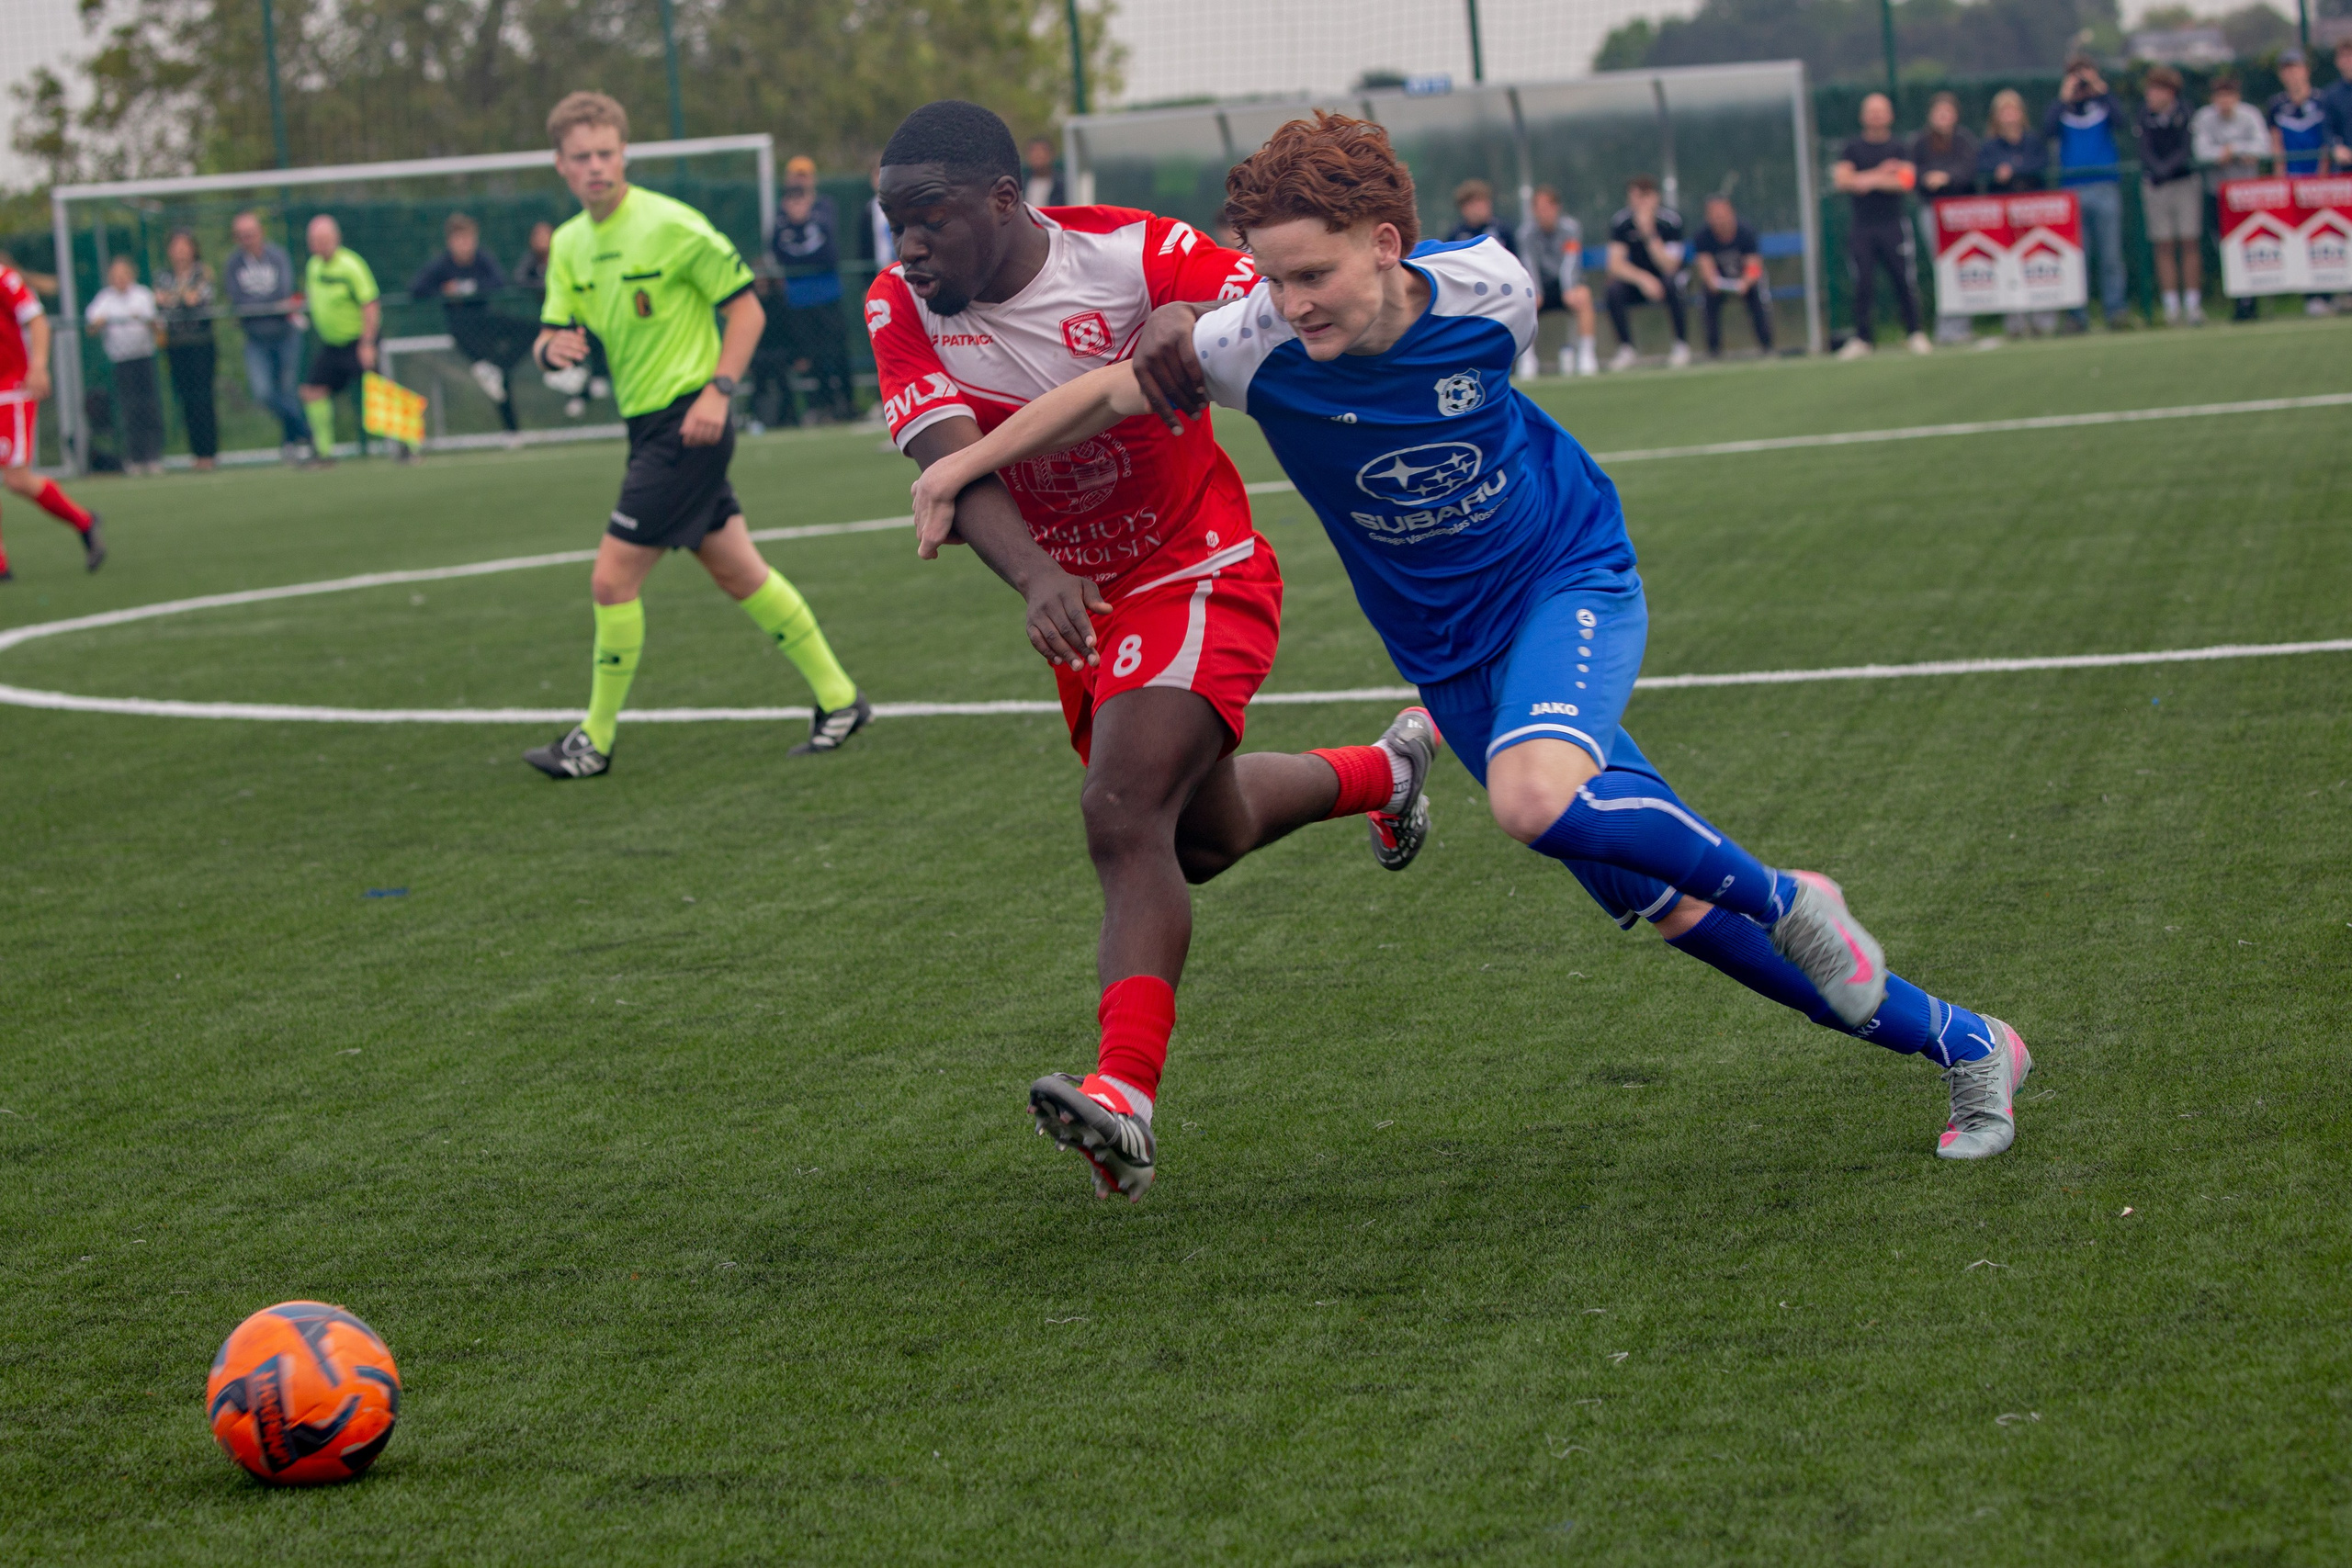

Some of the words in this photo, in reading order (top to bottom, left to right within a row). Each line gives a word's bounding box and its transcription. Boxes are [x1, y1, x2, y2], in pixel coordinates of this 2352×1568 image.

[1217, 256, 1255, 301] BV
[884, 382, 934, 429] BVL
[1350, 469, 1508, 534] SUBARU
[1406, 518, 1470, 545] Vandenplas
[1113, 634, 1142, 678] 8
[1529, 702, 1579, 716] JAKO
